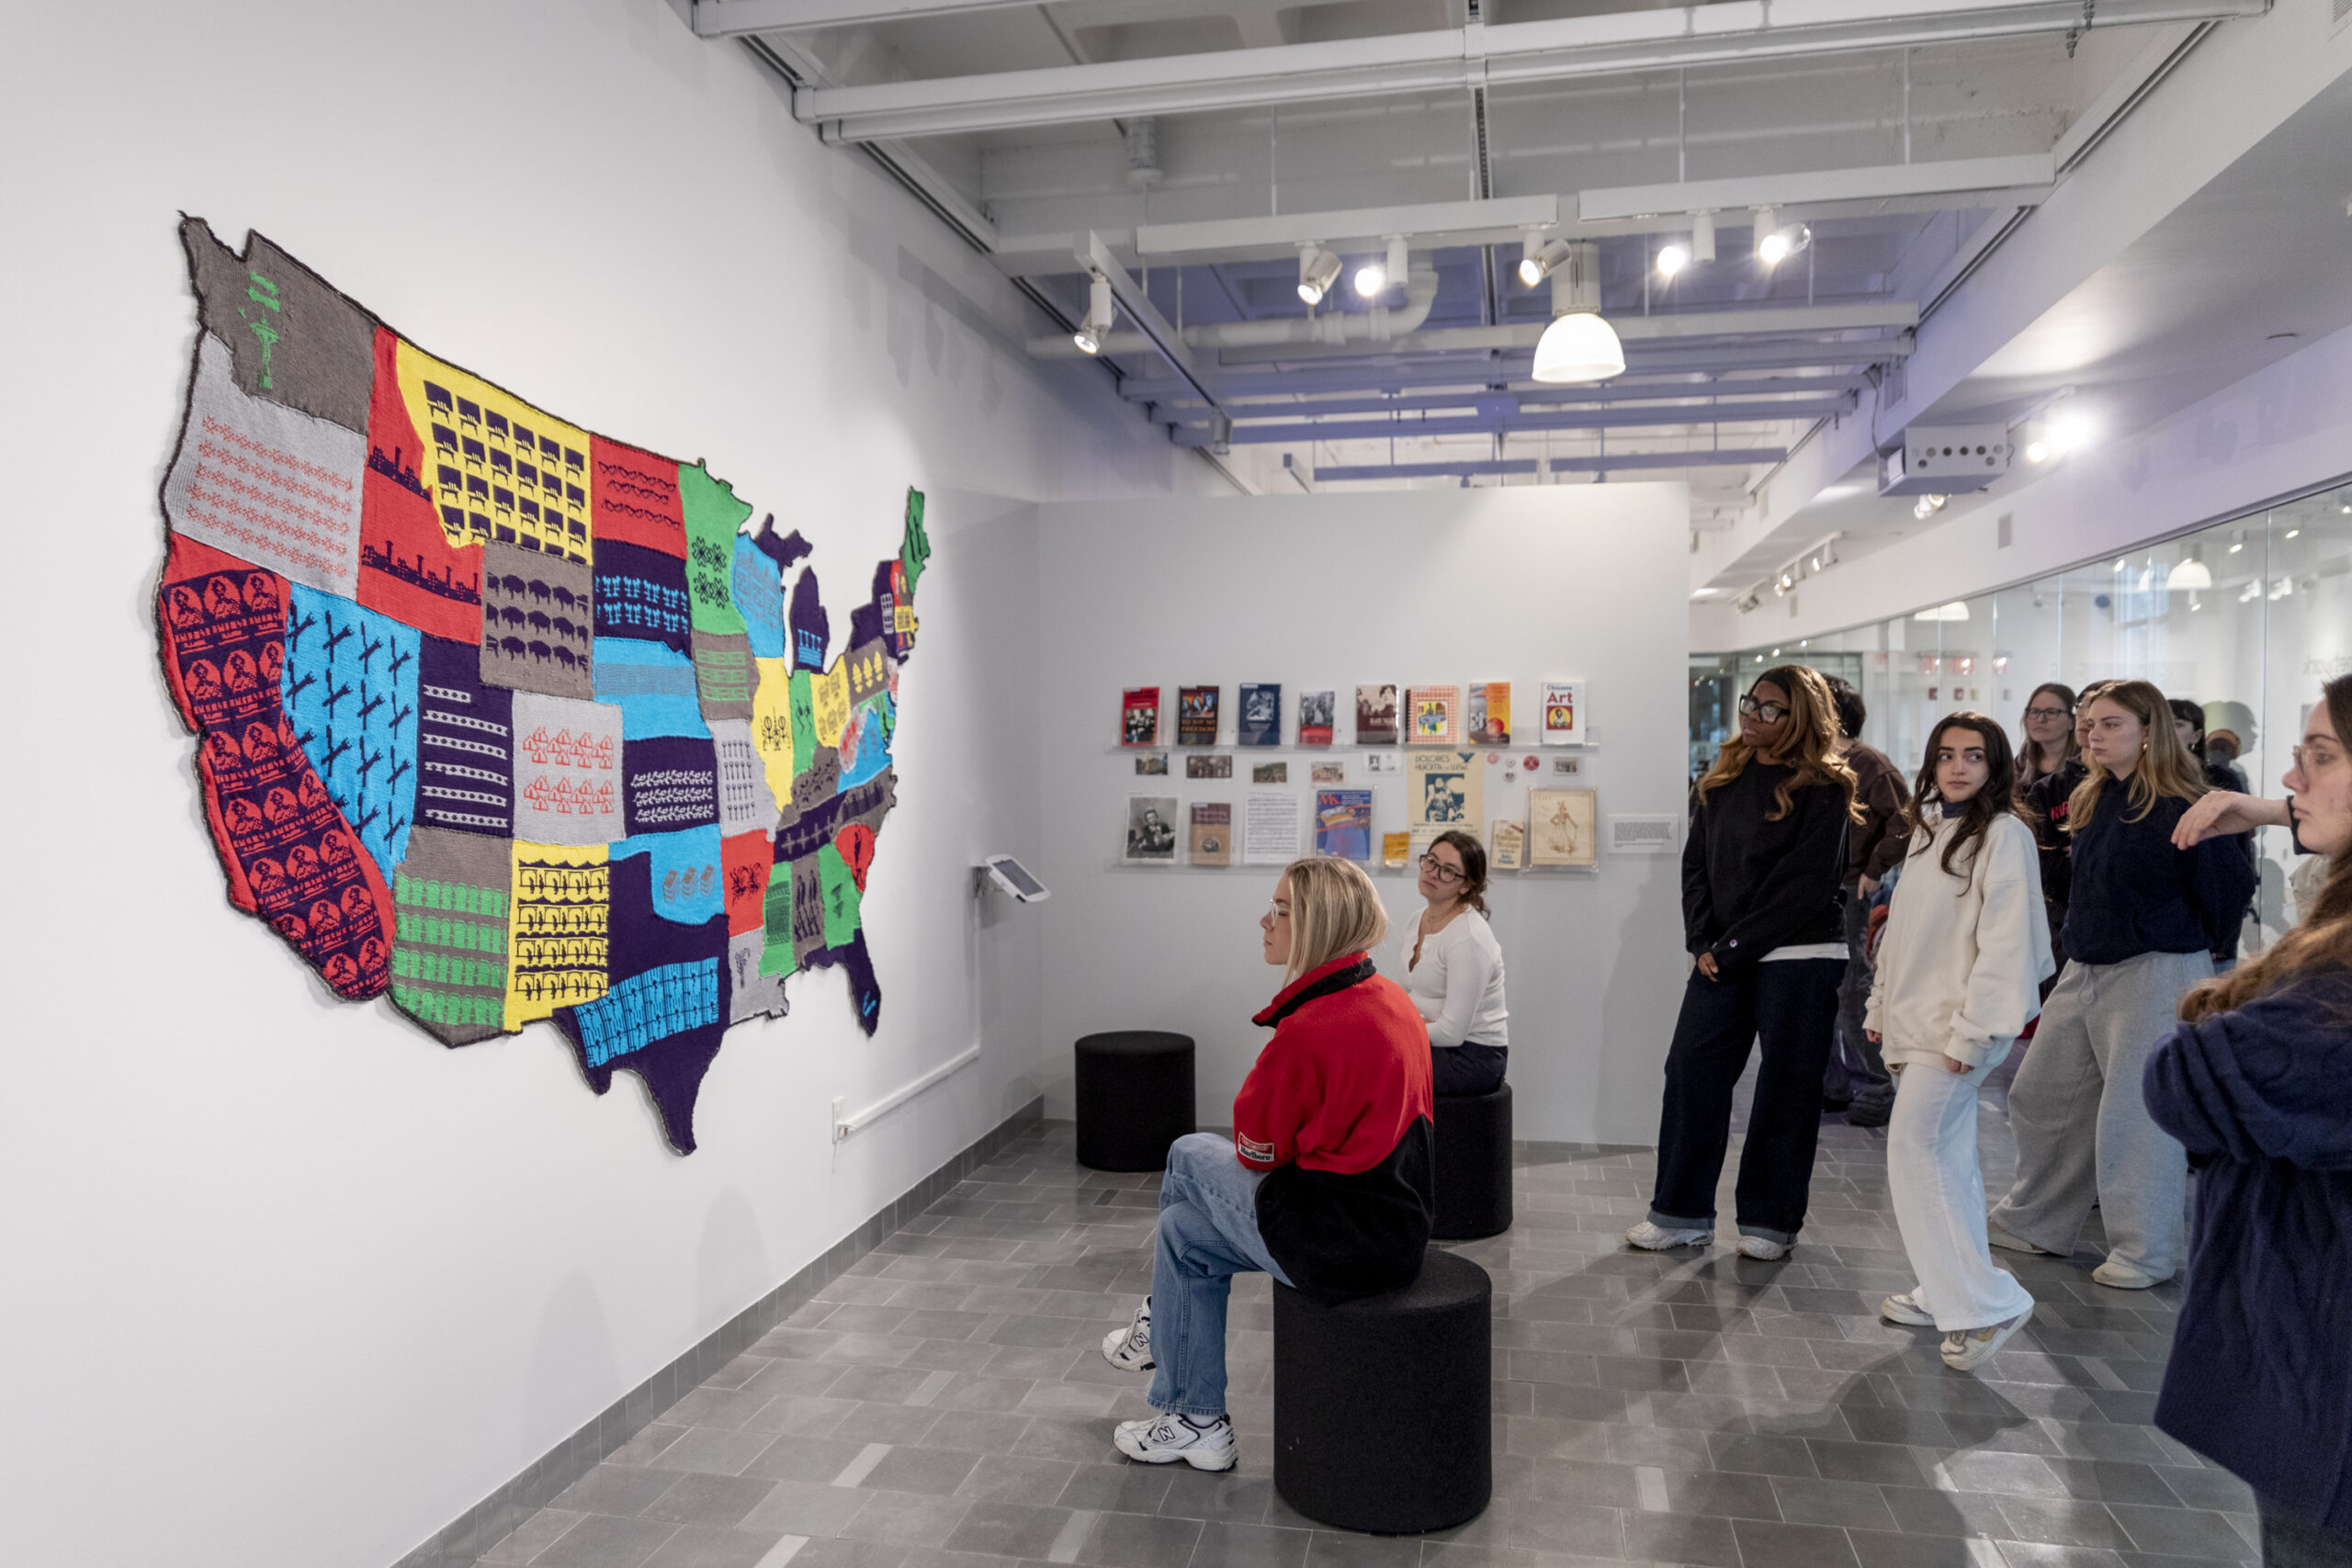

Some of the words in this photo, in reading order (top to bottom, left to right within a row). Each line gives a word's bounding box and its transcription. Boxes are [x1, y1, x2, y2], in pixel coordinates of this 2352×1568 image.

[1546, 691, 1573, 704] Art
[1415, 754, 1450, 762] DOLORES
[1318, 794, 1342, 806] Ms.
[1241, 1145, 1271, 1161] Marlboro
[1134, 1332, 1149, 1348] N
[1158, 1426, 1176, 1442] N
